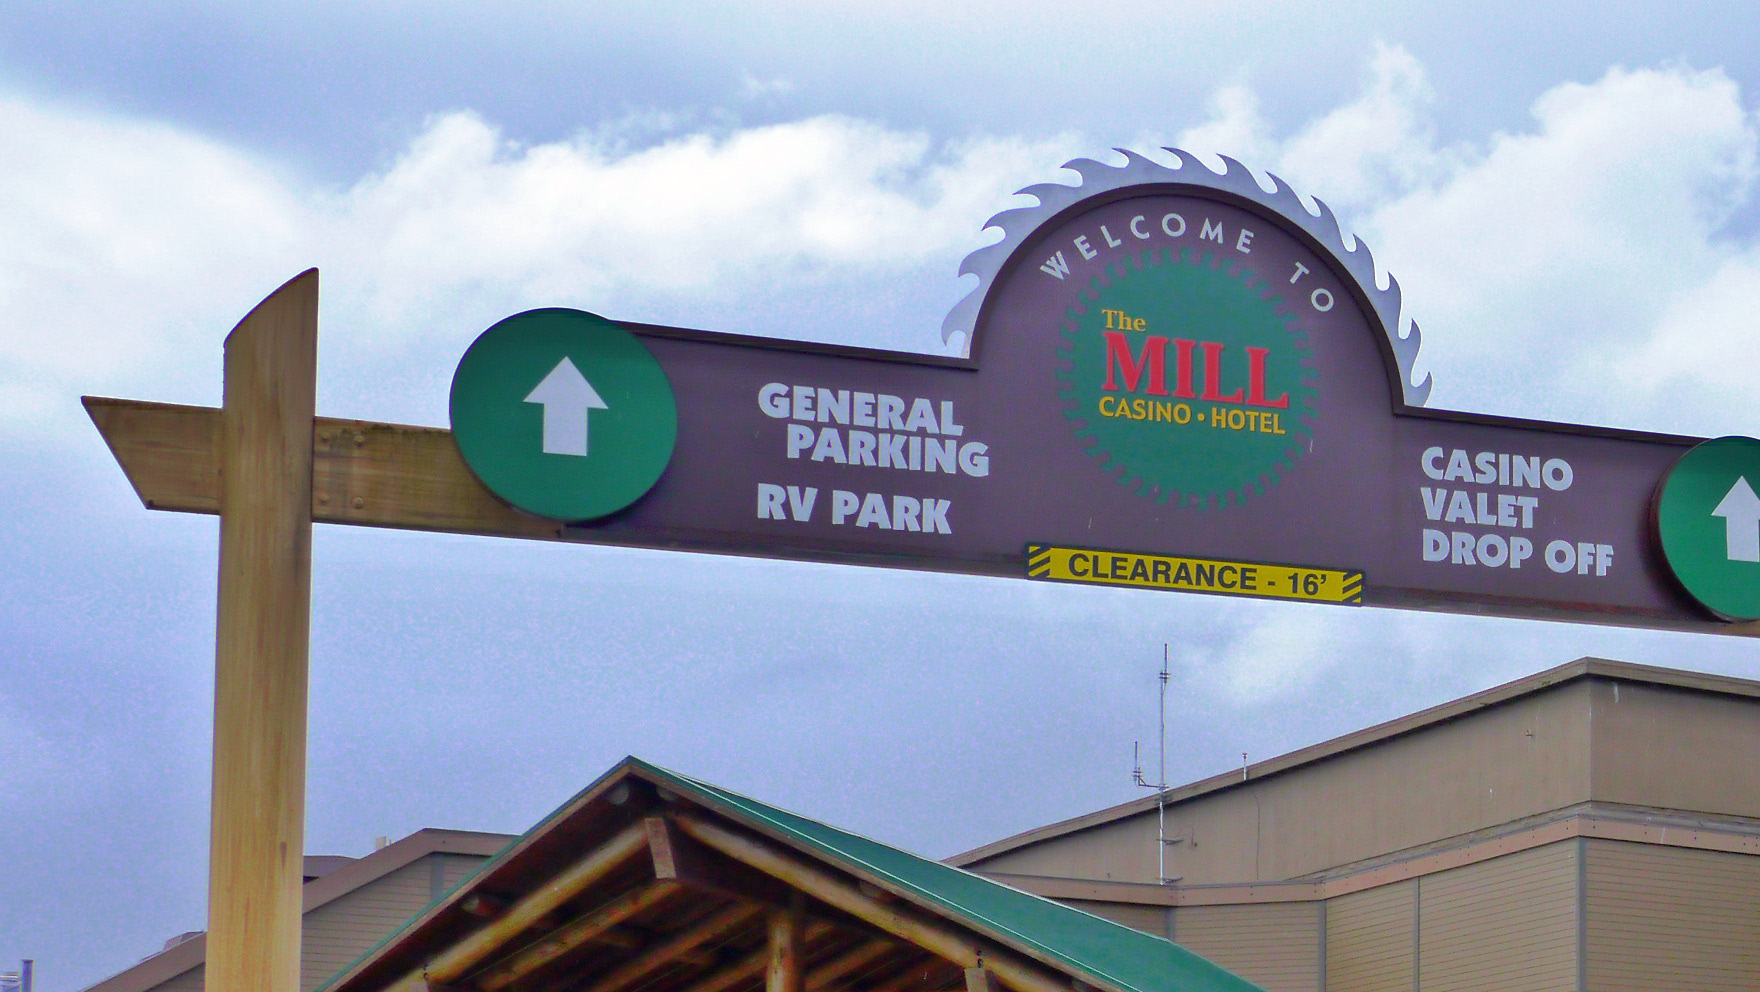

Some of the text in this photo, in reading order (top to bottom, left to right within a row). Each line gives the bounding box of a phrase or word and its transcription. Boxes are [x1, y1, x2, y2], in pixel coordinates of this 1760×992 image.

[1040, 213, 1335, 312] WELCOME TO
[1102, 309, 1147, 332] The
[1101, 330, 1290, 409] MILL
[758, 383, 964, 437] GENERAL
[1099, 396, 1286, 435] CASINO HOTEL
[787, 424, 990, 477] PARKING
[1421, 446, 1574, 491] CASINO
[757, 483, 952, 535] RV PARK
[1420, 487, 1539, 529] VALET
[1068, 554, 1257, 591] CLEARANCE
[1422, 528, 1615, 576] DROP OFF
